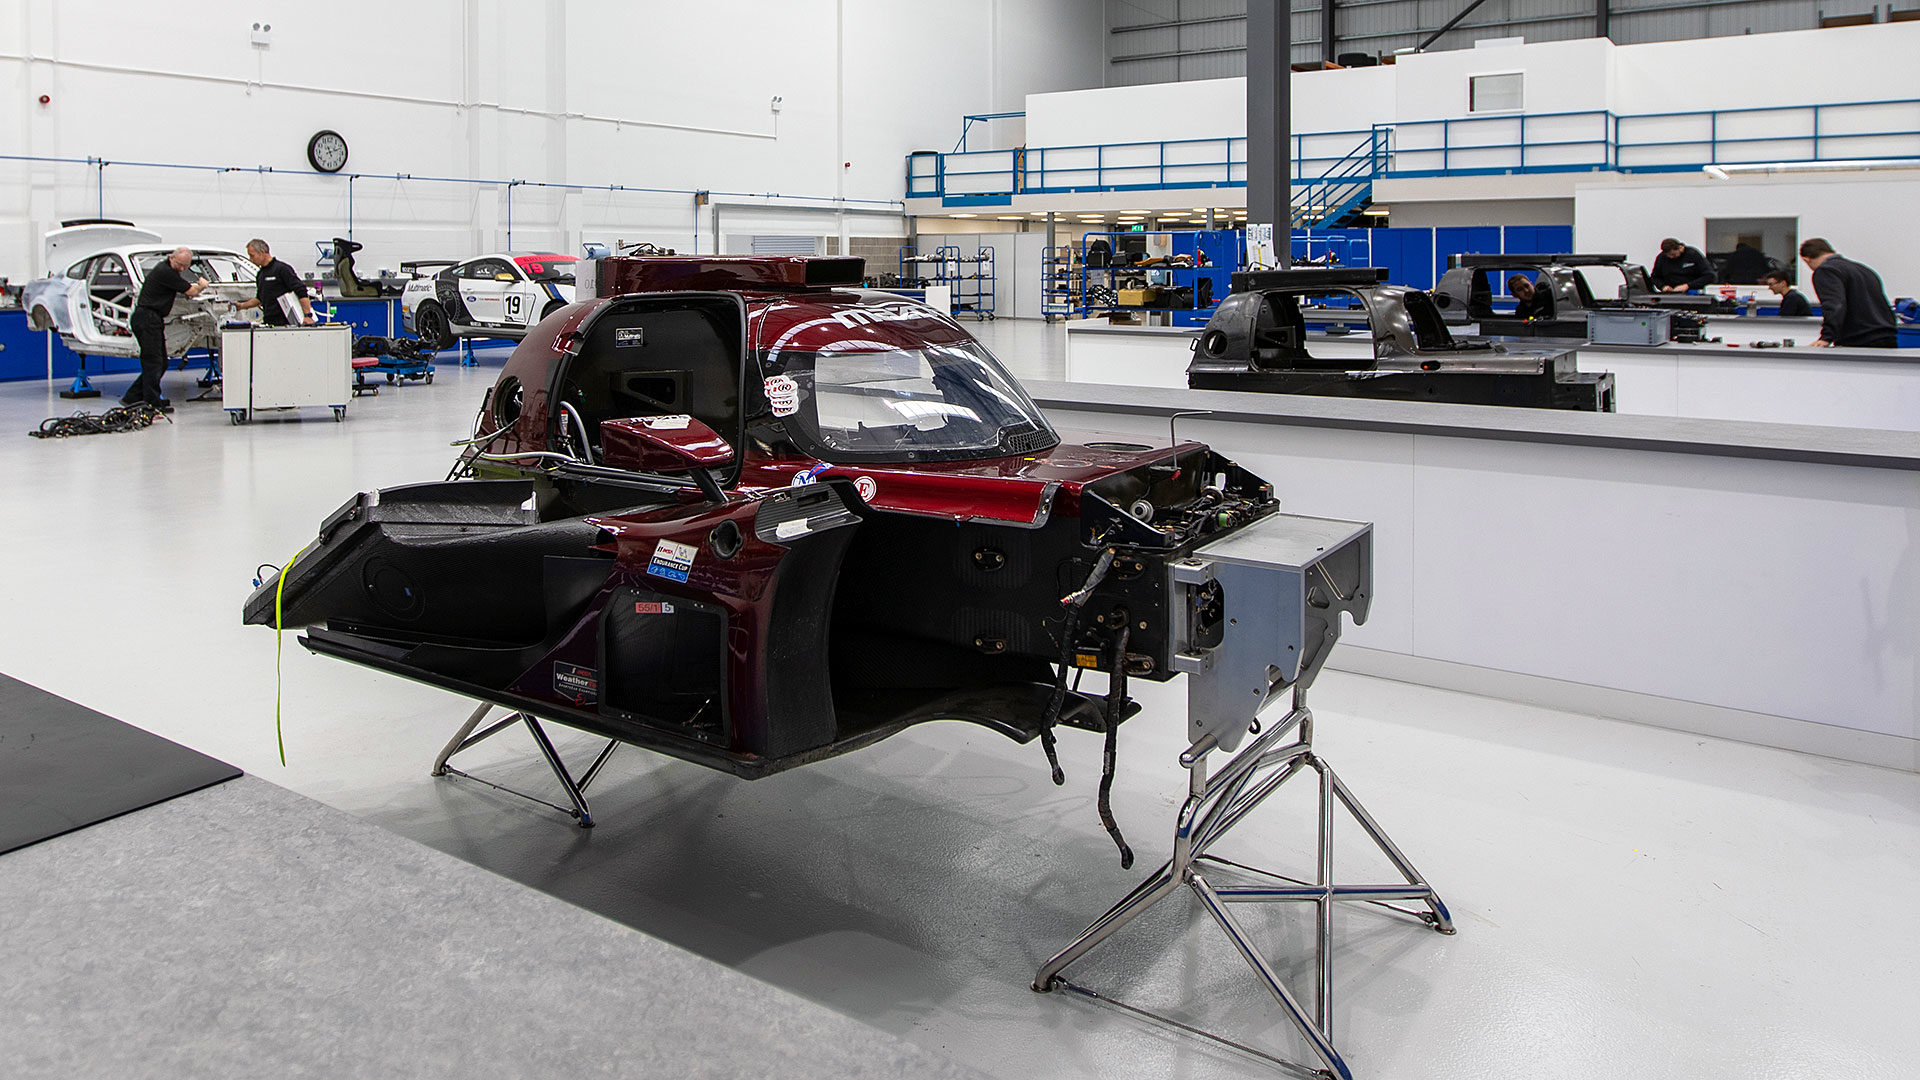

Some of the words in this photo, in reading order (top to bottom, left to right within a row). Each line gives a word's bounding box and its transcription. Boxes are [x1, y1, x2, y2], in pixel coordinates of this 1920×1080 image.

[521, 263, 545, 274] 19
[505, 296, 521, 314] 19
[556, 672, 598, 688] WeatherTe
